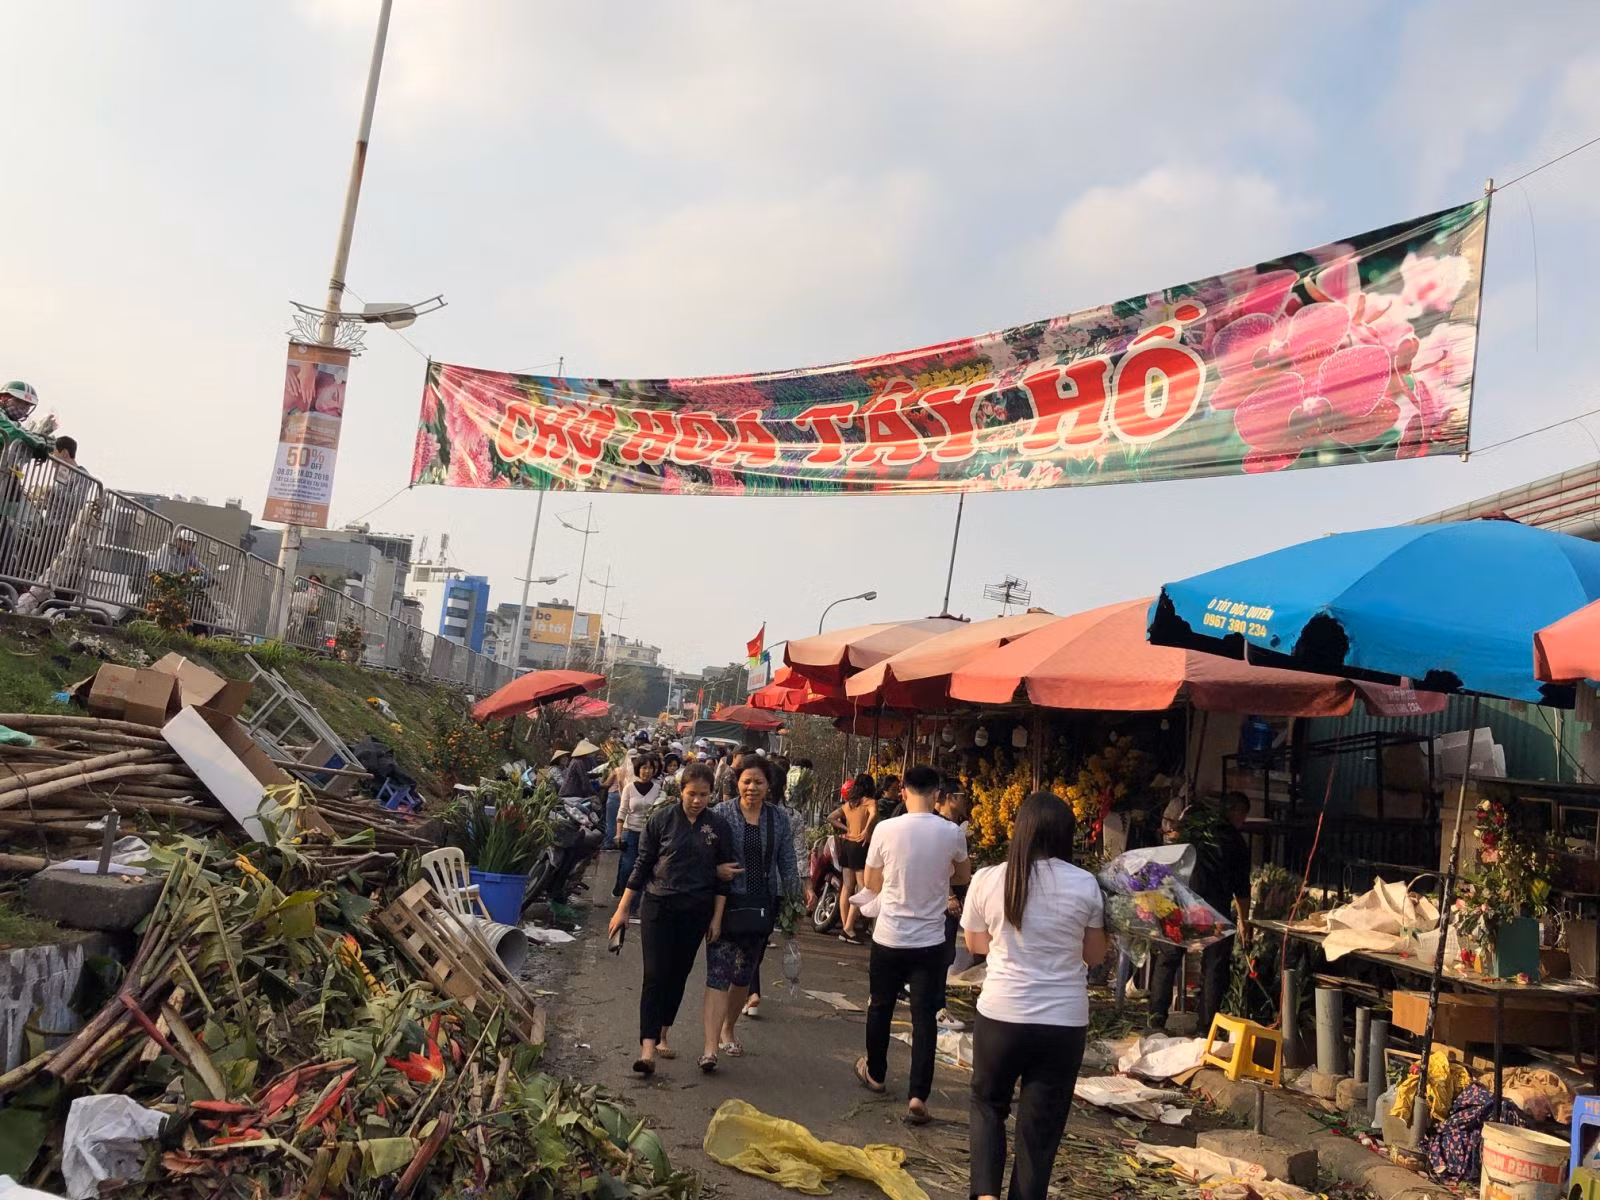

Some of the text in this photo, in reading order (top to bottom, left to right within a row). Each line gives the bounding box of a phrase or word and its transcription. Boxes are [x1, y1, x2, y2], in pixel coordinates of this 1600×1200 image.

[496, 401, 617, 479] CHỢ
[619, 409, 781, 468] HOA
[793, 377, 1000, 467] TÂY
